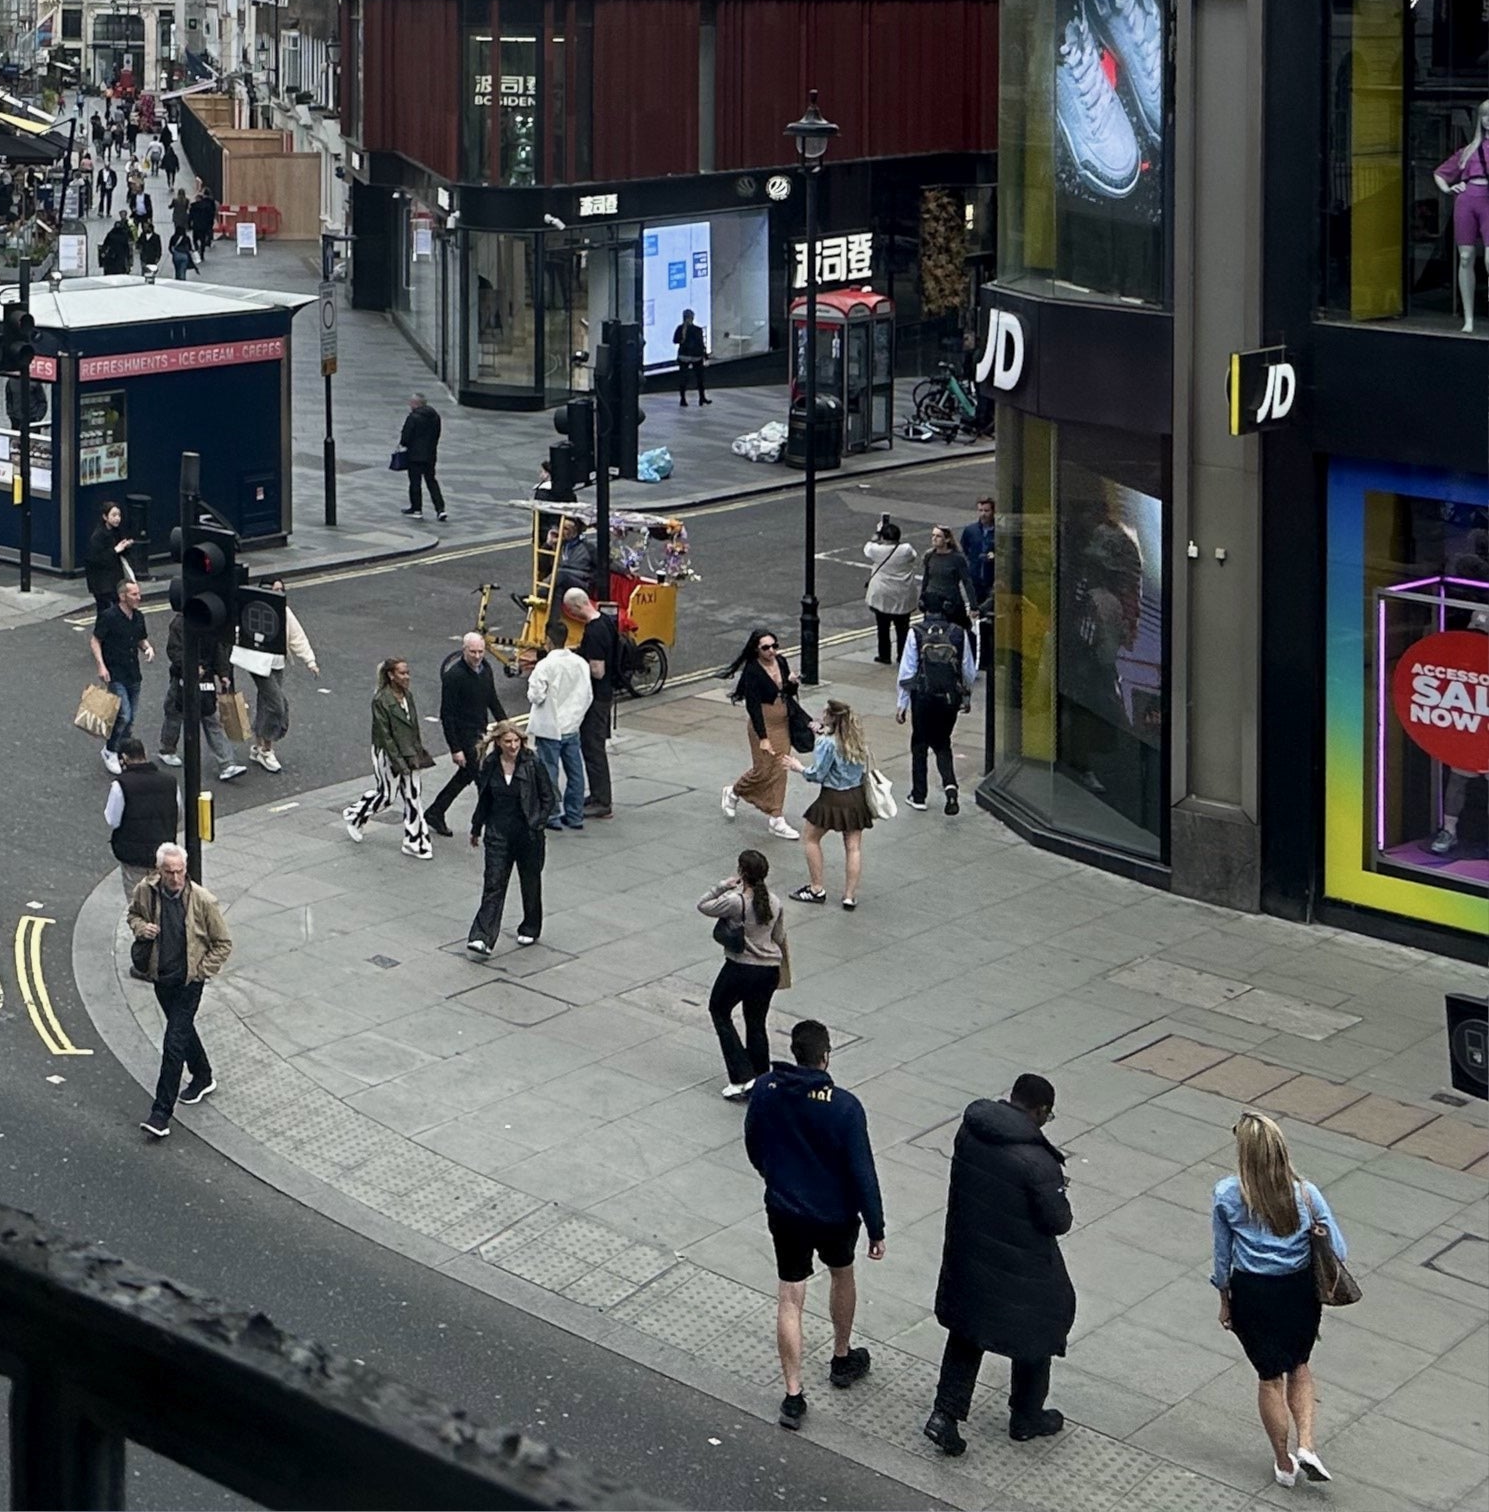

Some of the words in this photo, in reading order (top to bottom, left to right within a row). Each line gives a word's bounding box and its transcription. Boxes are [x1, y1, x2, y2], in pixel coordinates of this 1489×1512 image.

[81, 355, 168, 377] REFRESHMENTS
[178, 352, 196, 366] ICE
[199, 347, 234, 364] CREAM
[241, 341, 282, 359] CREPES
[975, 308, 1025, 391] JD
[1256, 363, 1296, 423] JD
[1411, 662, 1489, 686] ACCESSO
[1411, 675, 1489, 717] SAL
[1410, 703, 1482, 733] NOW
